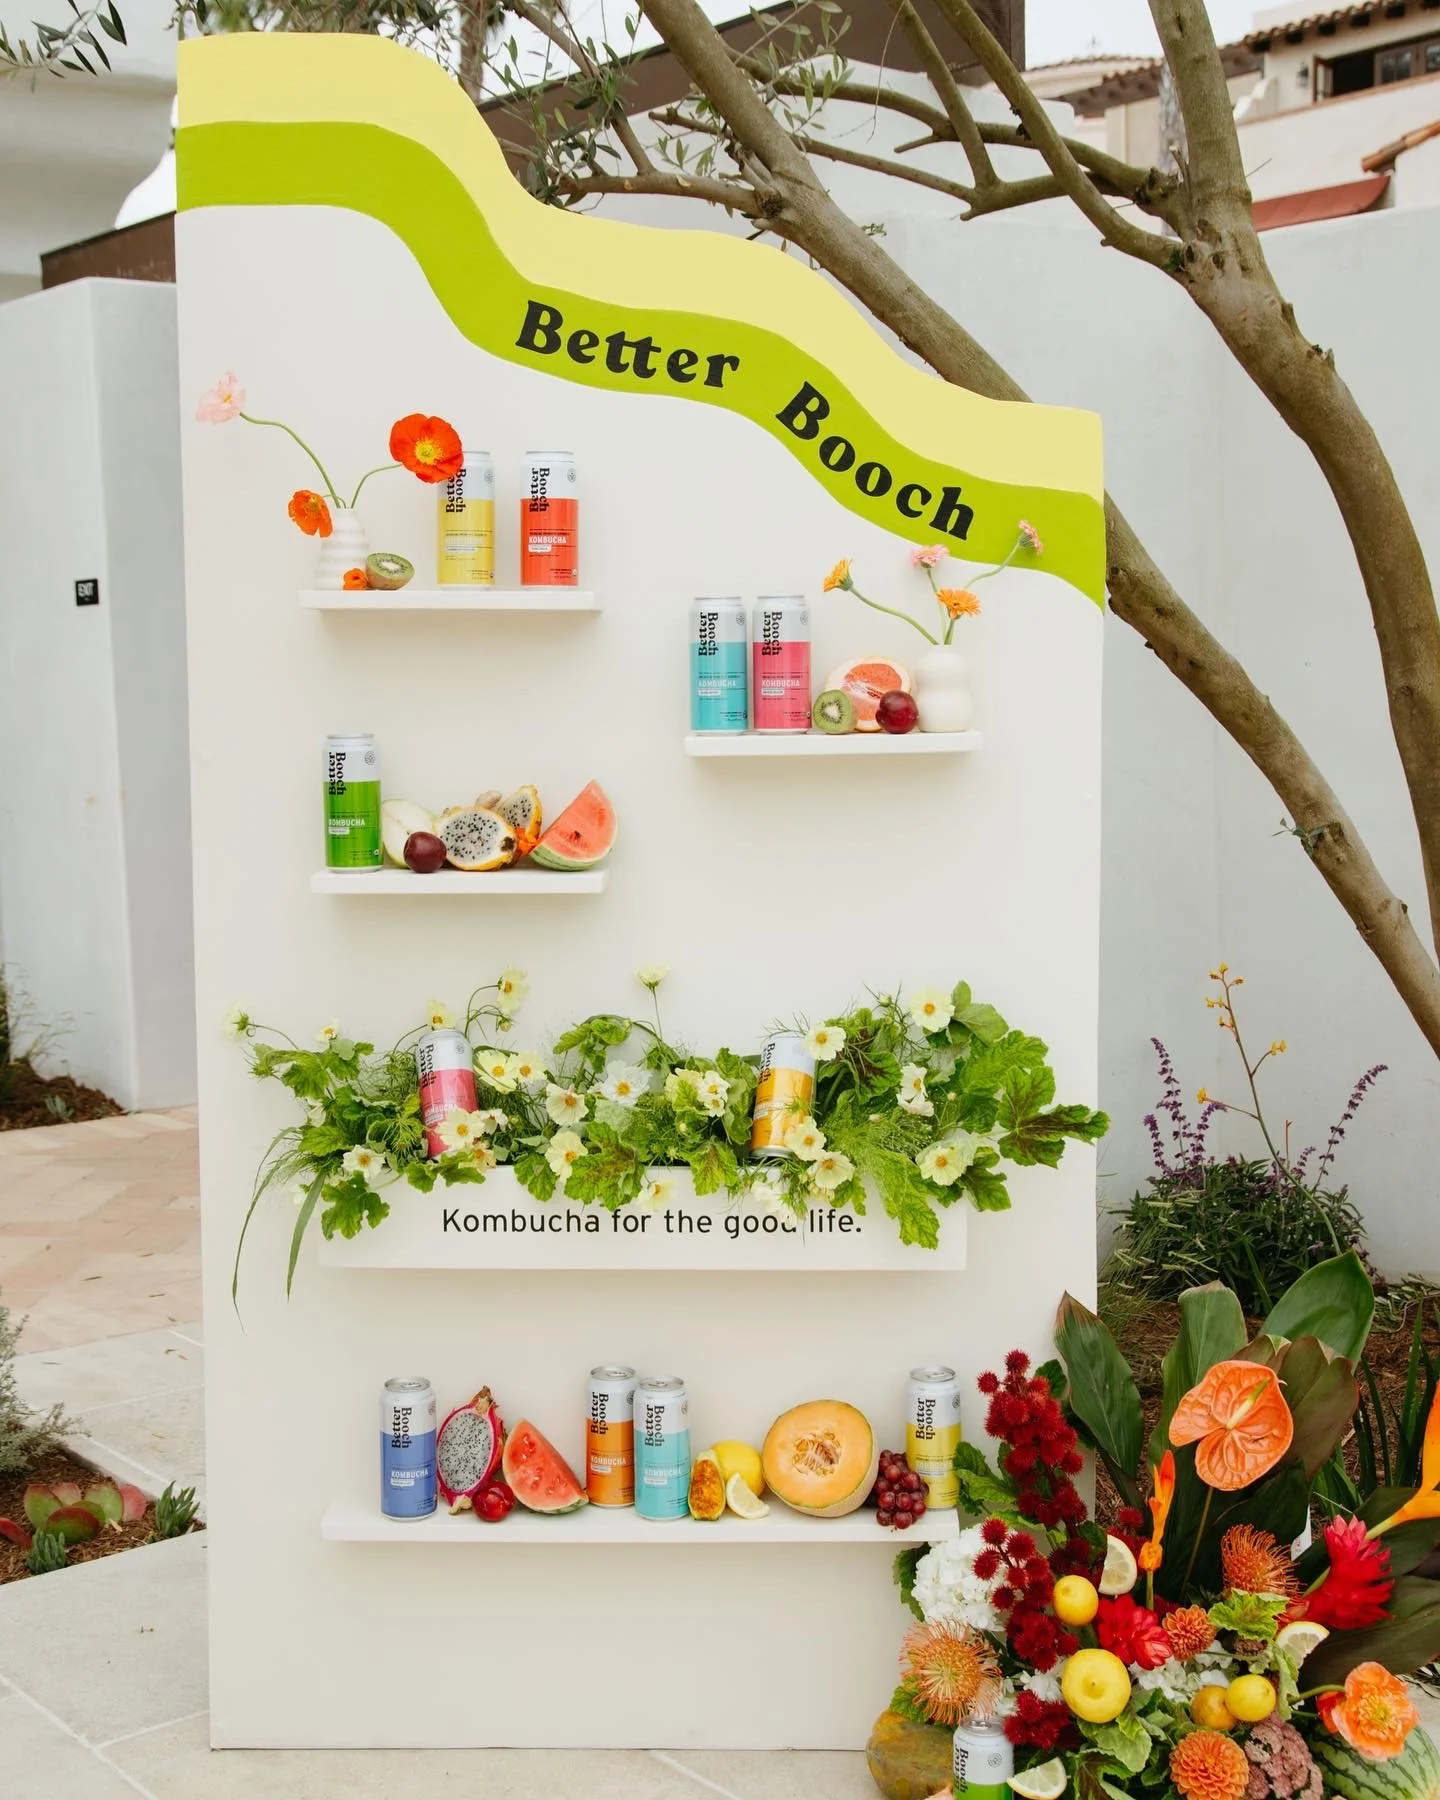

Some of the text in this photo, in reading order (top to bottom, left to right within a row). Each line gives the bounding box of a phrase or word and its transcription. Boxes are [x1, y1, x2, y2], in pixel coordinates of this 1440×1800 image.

[515, 299, 974, 541] Better Booch
[445, 475, 455, 513] Bette
[456, 468, 466, 513] Booch
[529, 467, 539, 513] Better
[539, 467, 550, 513] Booch
[528, 536, 567, 544] KOMBUCHA
[698, 611, 707, 656] Better
[708, 611, 719, 656] Booch
[761, 611, 771, 656] Better
[771, 611, 782, 656] Booch
[328, 751, 336, 796] Better
[336, 751, 347, 796] Booch
[329, 818, 366, 827] KOMBUCHA
[425, 1043, 437, 1085] Booch
[762, 1042, 776, 1082] Booch
[443, 1208, 600, 1233] Kombucha
[612, 1208, 652, 1233] for
[664, 1209, 712, 1233] the
[809, 1208, 862, 1233] life.
[391, 1406, 401, 1449] Better
[401, 1406, 412, 1449] Booch
[590, 1391, 599, 1434] Better
[599, 1392, 609, 1435] Booch
[644, 1403, 654, 1447] Better
[654, 1405, 665, 1447] Booch
[915, 1397, 925, 1440] Better
[925, 1398, 936, 1440] Booch
[391, 1469, 429, 1479] KOMBUCHA
[959, 1747, 969, 1793] Booch
